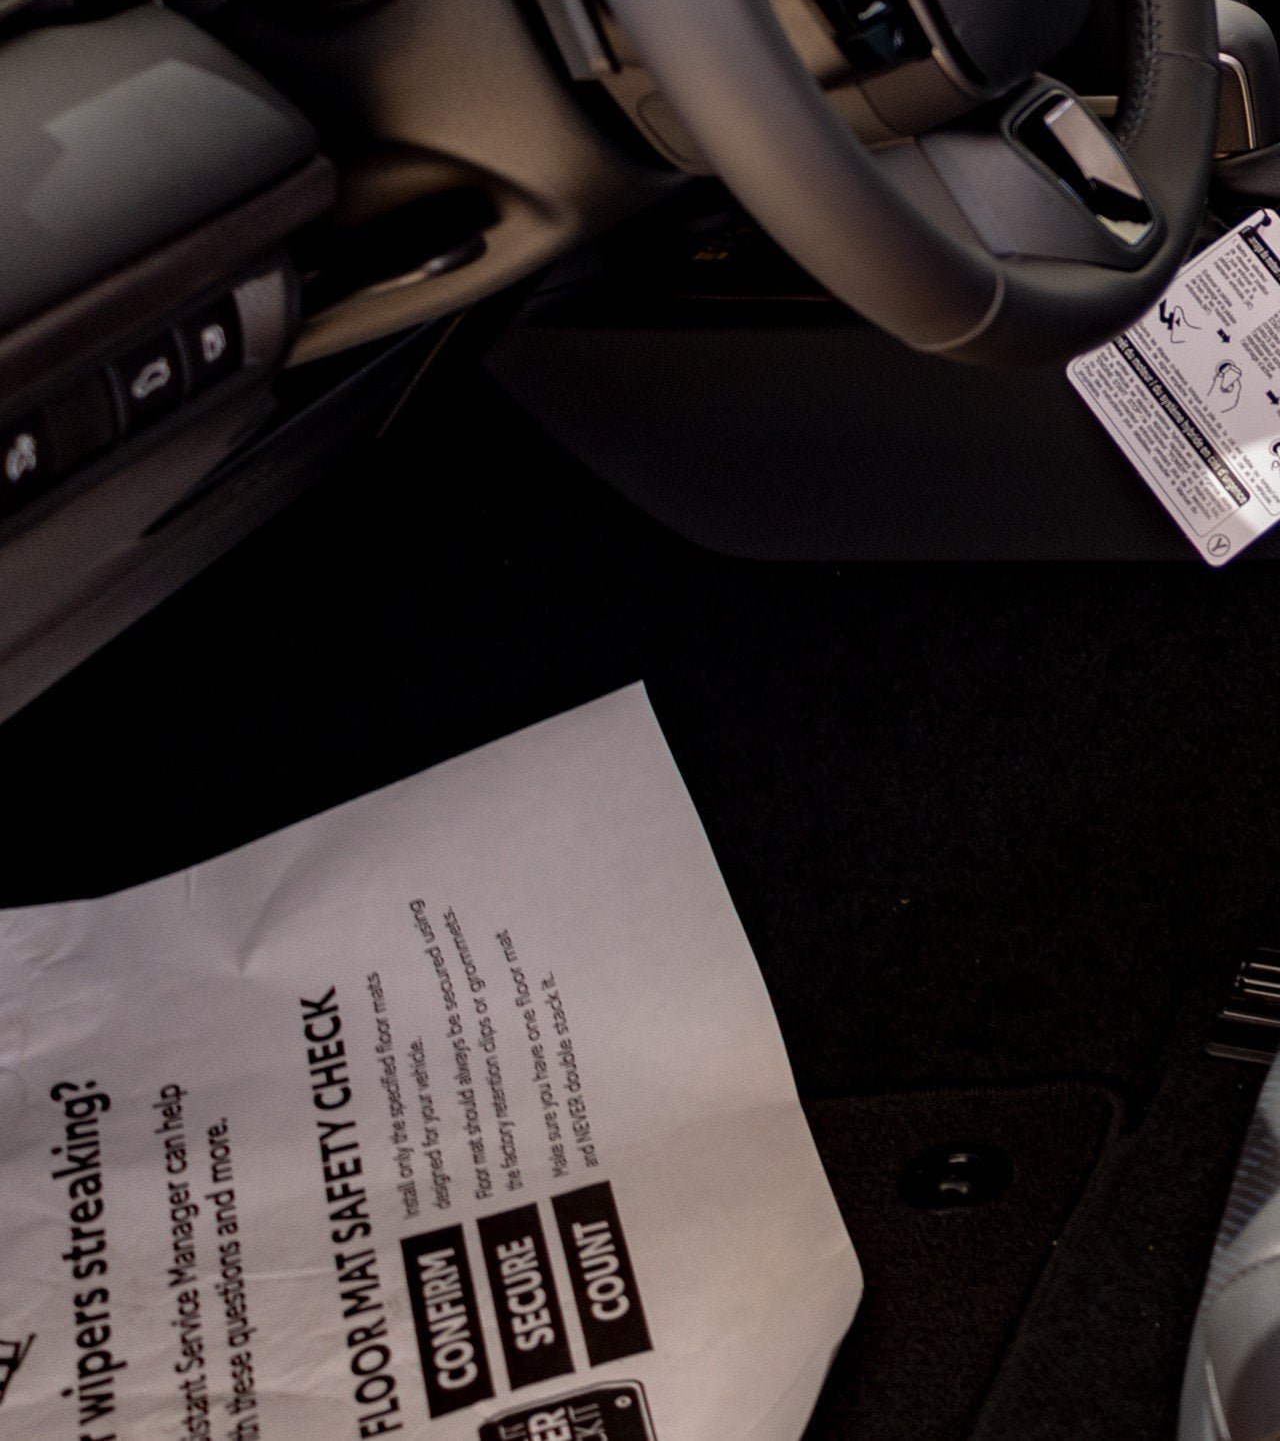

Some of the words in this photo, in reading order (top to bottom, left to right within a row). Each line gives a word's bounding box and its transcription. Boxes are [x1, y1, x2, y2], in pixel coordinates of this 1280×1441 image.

[1208, 536, 1227, 555] Y
[408, 898, 436, 944] using
[442, 905, 486, 993] grommets.
[366, 971, 386, 1015] mats
[424, 945, 458, 1012] secured
[509, 967, 532, 1008] floor
[446, 1013, 463, 1038] be
[473, 997, 488, 1015] or
[523, 1008, 541, 1042] one
[545, 990, 569, 1036] stack
[300, 985, 353, 1111] CHECK
[374, 1017, 393, 1054] floor
[478, 1016, 497, 1054] clips
[452, 1037, 473, 1086] always
[531, 1044, 548, 1083] have
[556, 1038, 582, 1093] double
[153, 1083, 188, 1135] help
[378, 1054, 405, 1119] specified
[418, 1093, 441, 1125] your
[538, 1082, 560, 1110] you
[390, 1120, 408, 1145] the
[456, 1088, 482, 1136] should
[544, 1111, 562, 1142] sure
[566, 1095, 591, 1144] NEVER
[163, 1134, 188, 1175] can
[206, 1117, 233, 1184] more.
[421, 1126, 439, 1148] for
[498, 1120, 518, 1170] factory
[577, 1144, 599, 1168] and
[49, 1079, 112, 1281] streaking?
[316, 1120, 372, 1245] SAFETY
[393, 1147, 415, 1179] only
[424, 1149, 452, 1210] designed
[167, 1182, 200, 1288] Manager
[205, 1188, 239, 1237] and
[214, 1240, 257, 1348] questions
[334, 1248, 383, 1319] MAT
[496, 1236, 555, 1351] SECURE
[571, 1220, 630, 1321] COUNT
[171, 1288, 205, 1374] Service
[417, 1248, 478, 1390] CONFIRM
[60, 1287, 128, 1427] wipers
[346, 1316, 403, 1440] FLOOR
[225, 1351, 258, 1416] these
